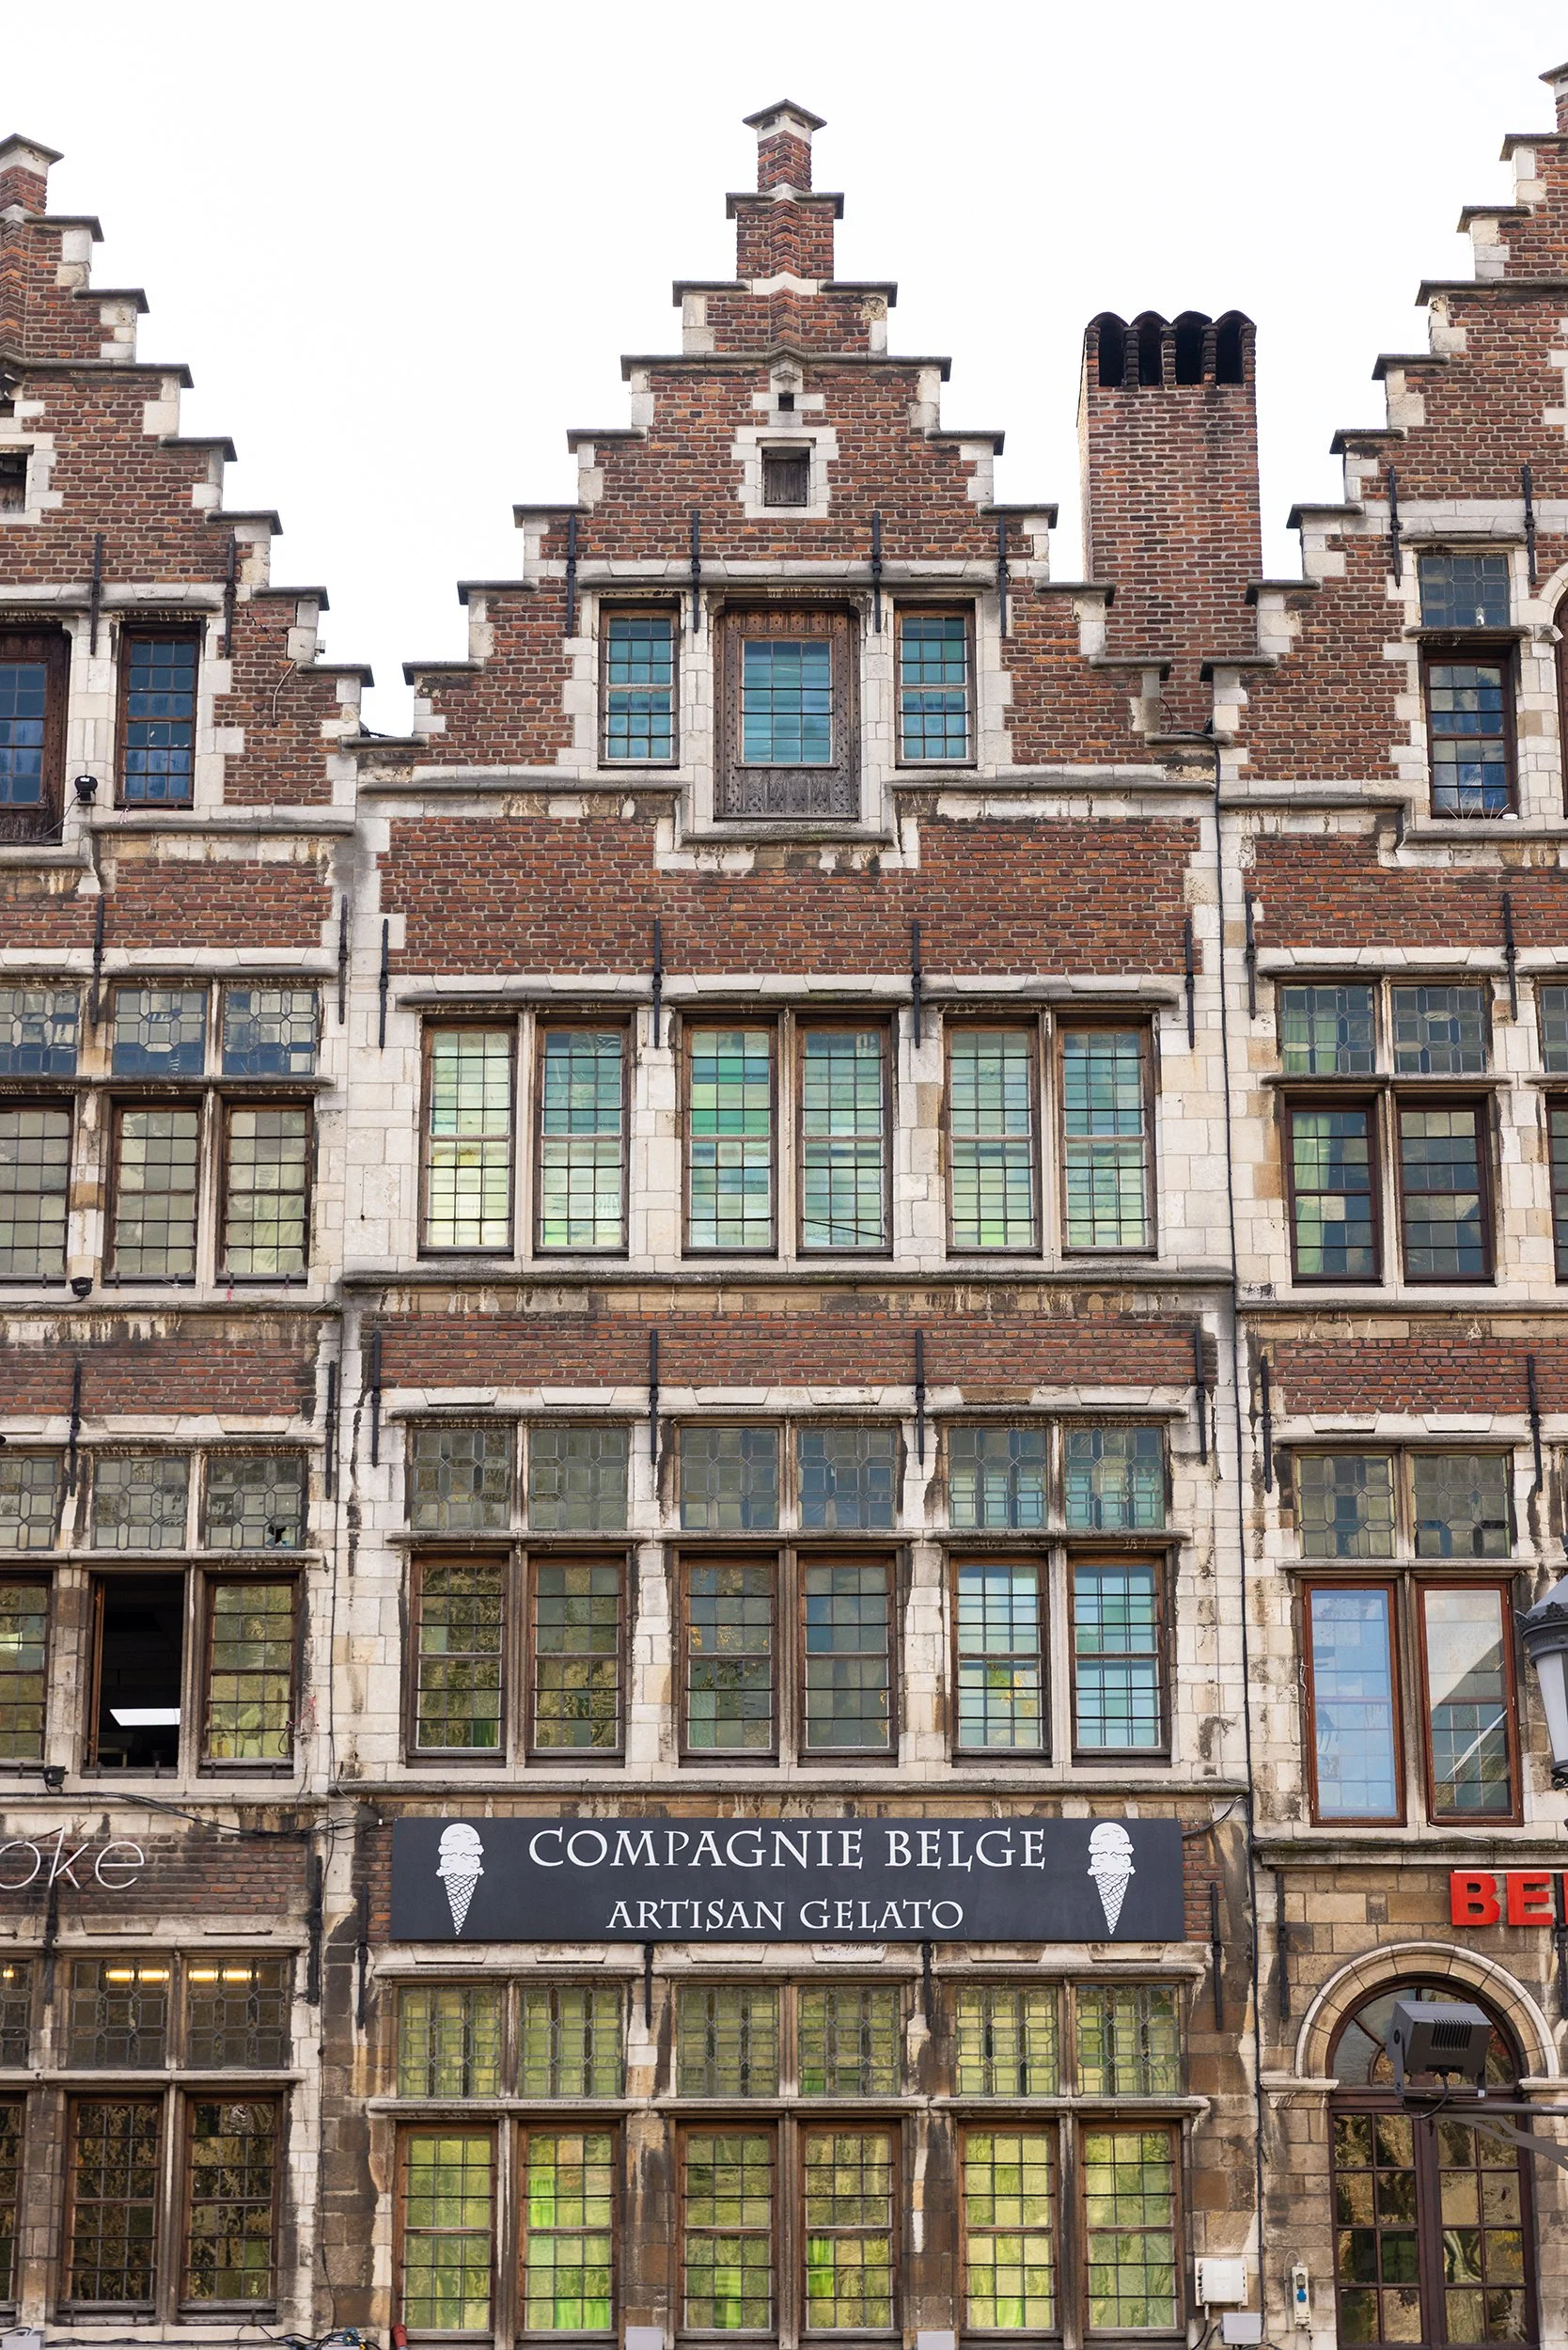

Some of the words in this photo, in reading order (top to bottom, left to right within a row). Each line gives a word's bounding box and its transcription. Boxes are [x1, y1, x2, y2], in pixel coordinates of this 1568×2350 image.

[528, 1826, 864, 1870] COMPAGNIE
[884, 1826, 1045, 1872] BELGE
[605, 1898, 785, 1933] ARTISAN
[799, 1897, 964, 1933] GELATO
[1450, 1872, 1568, 1926] BE
